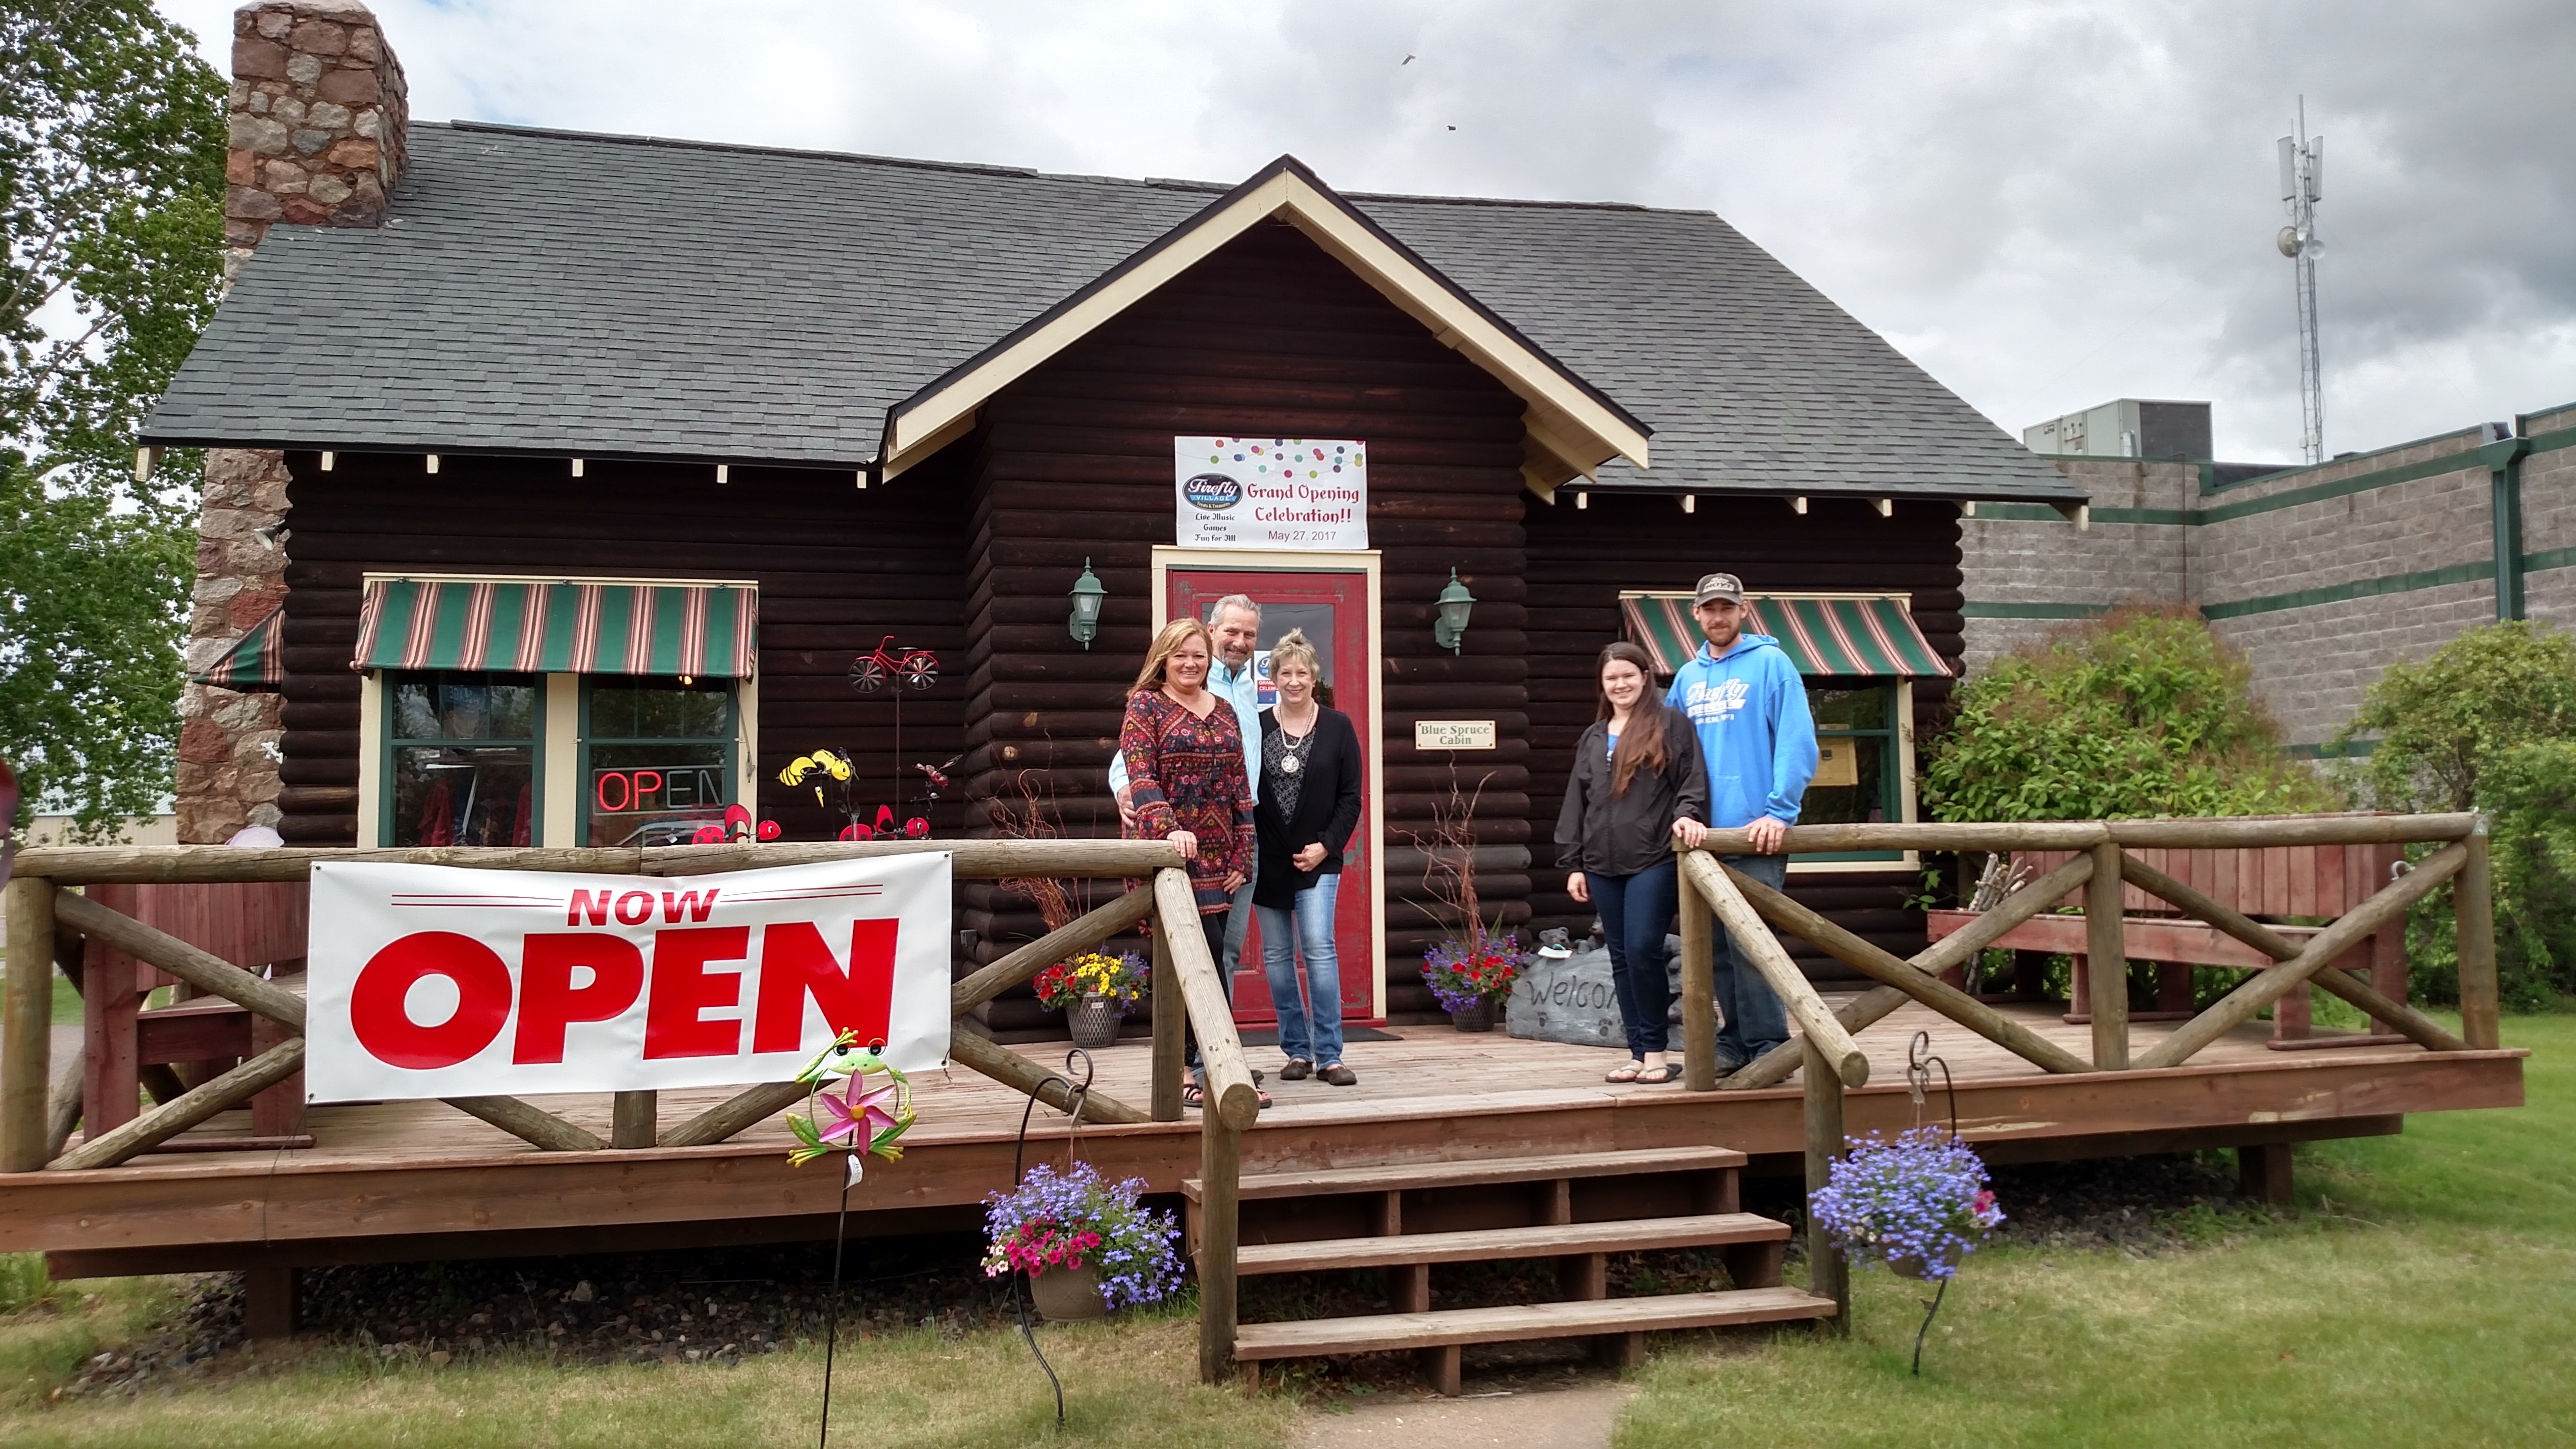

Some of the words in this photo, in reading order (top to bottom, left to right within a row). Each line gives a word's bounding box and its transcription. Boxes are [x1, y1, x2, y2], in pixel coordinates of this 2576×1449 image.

[1188, 479, 1238, 497] Firefly
[1247, 483, 1293, 501] Grand
[1298, 484, 1359, 504] Opening
[1255, 506, 1351, 525] Celebration!!
[1268, 531, 1290, 542] May
[1293, 531, 1309, 541] 27,
[1312, 531, 1337, 540] 2017
[1422, 725, 1446, 734] Blue
[1450, 725, 1490, 736] Spruce
[1440, 735, 1472, 745] Cabin
[598, 769, 725, 811] OPEN
[568, 888, 721, 927] NOW
[350, 917, 900, 1070] OPEN
[1526, 971, 1617, 1009] Welco
